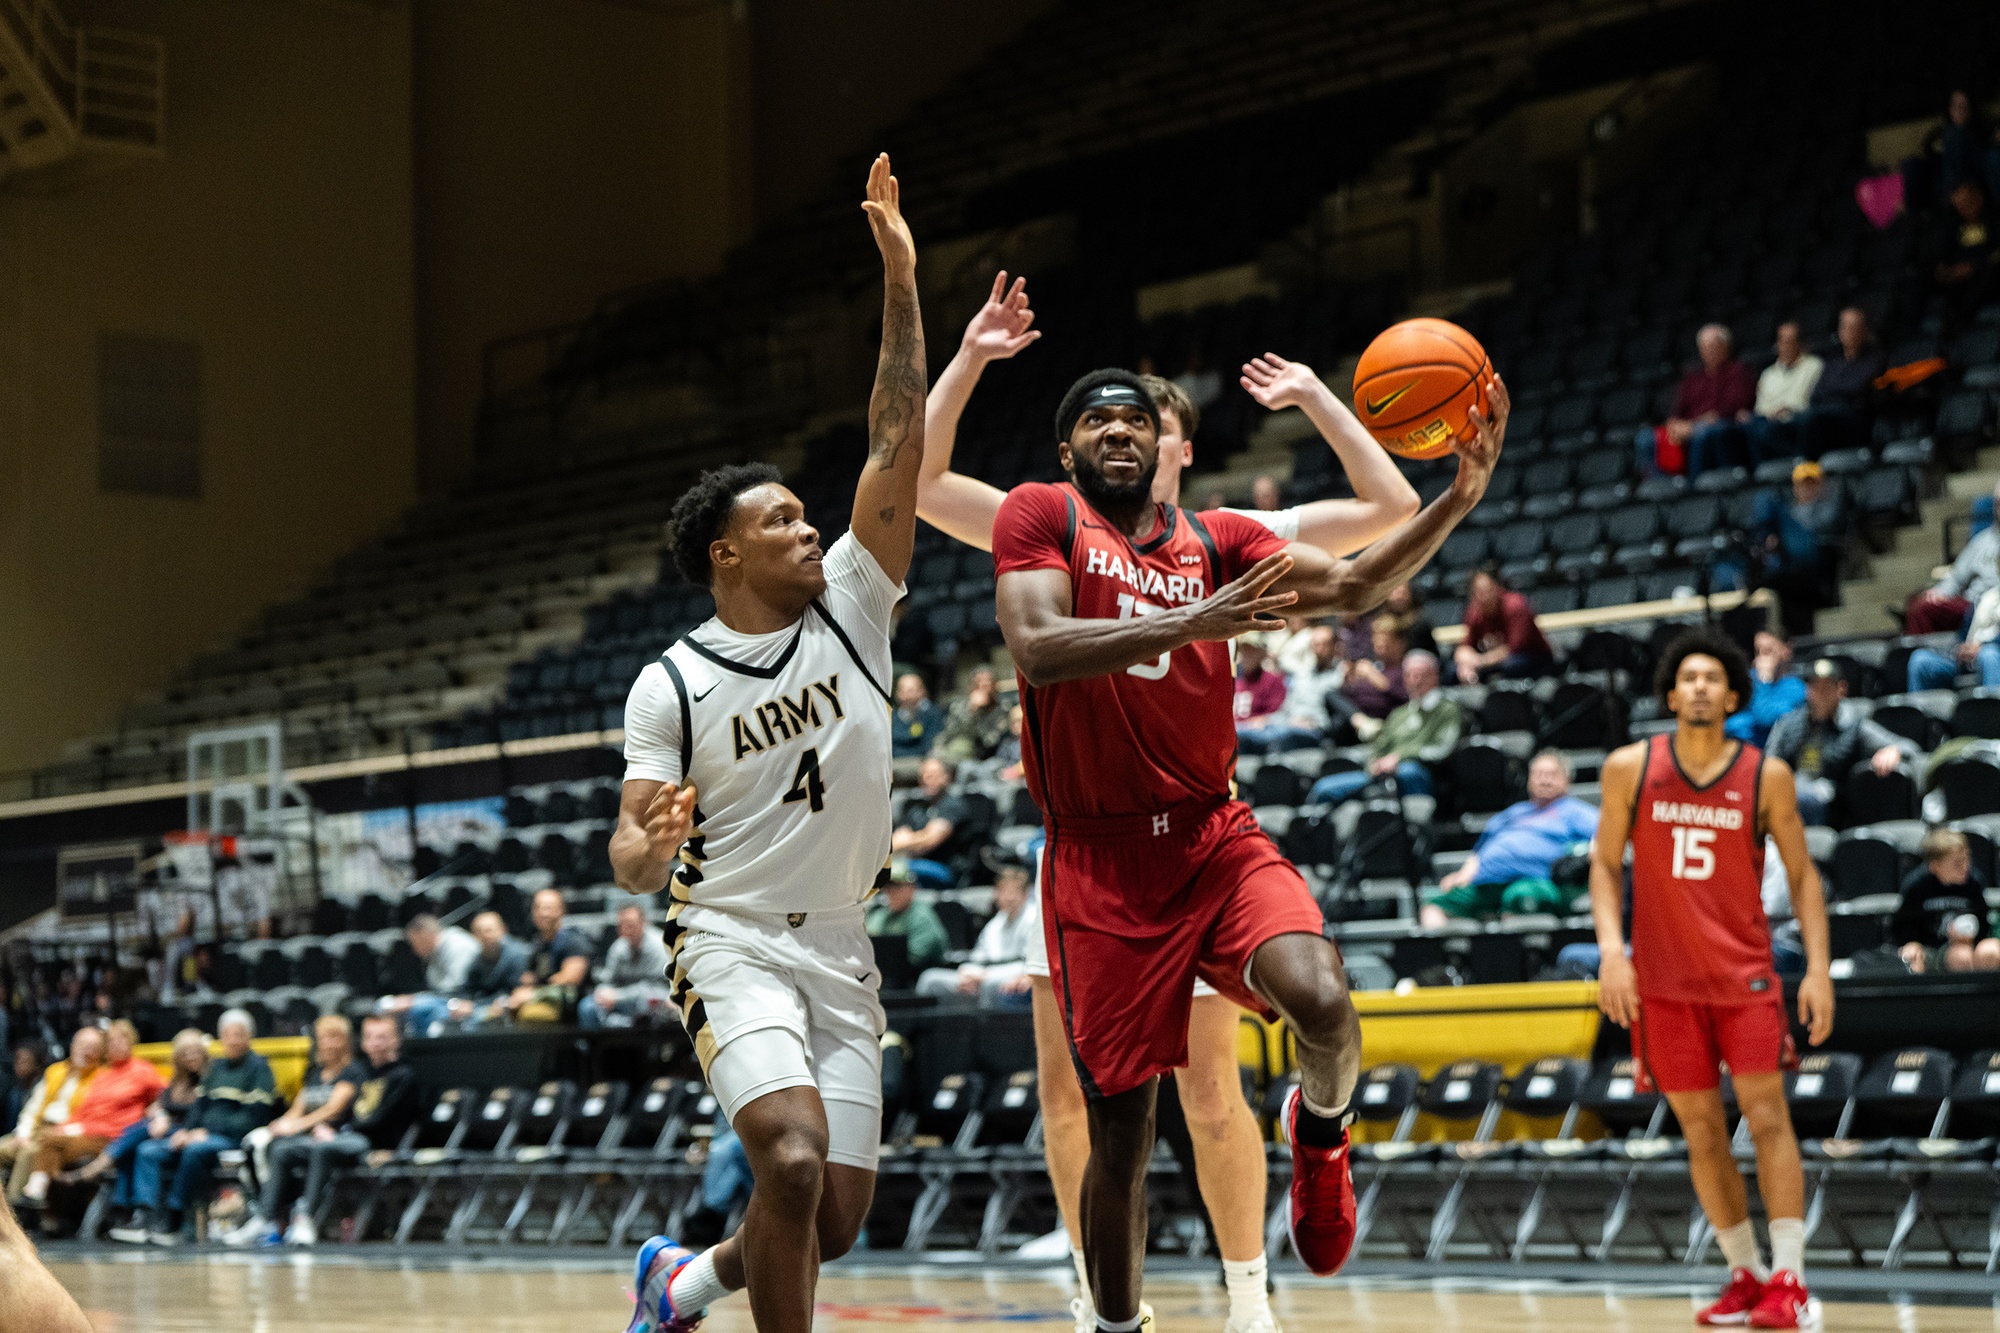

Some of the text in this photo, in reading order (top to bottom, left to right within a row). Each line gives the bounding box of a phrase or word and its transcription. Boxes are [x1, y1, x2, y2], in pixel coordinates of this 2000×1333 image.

[1086, 548, 1204, 603] HARVARD
[730, 673, 845, 763] ARMY
[782, 747, 825, 813] 4
[1152, 812, 1170, 836] H
[1652, 800, 1743, 830] HARVARD
[1671, 826, 1717, 880] 15
